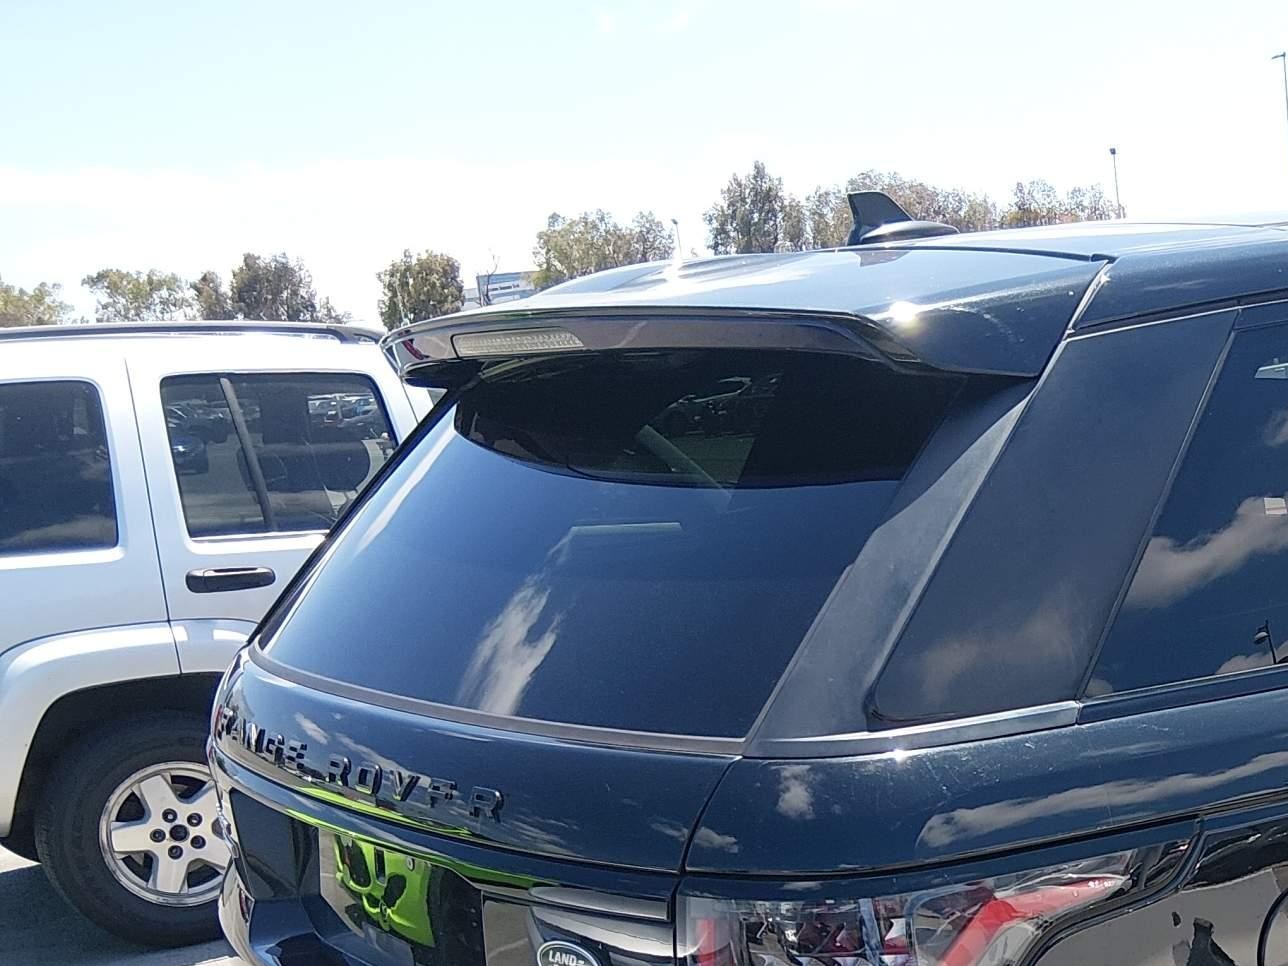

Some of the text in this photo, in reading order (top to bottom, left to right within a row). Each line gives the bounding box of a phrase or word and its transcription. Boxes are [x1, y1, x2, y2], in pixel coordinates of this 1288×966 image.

[217, 707, 504, 823] RANGE ROVER
[548, 949, 577, 966] LAND
